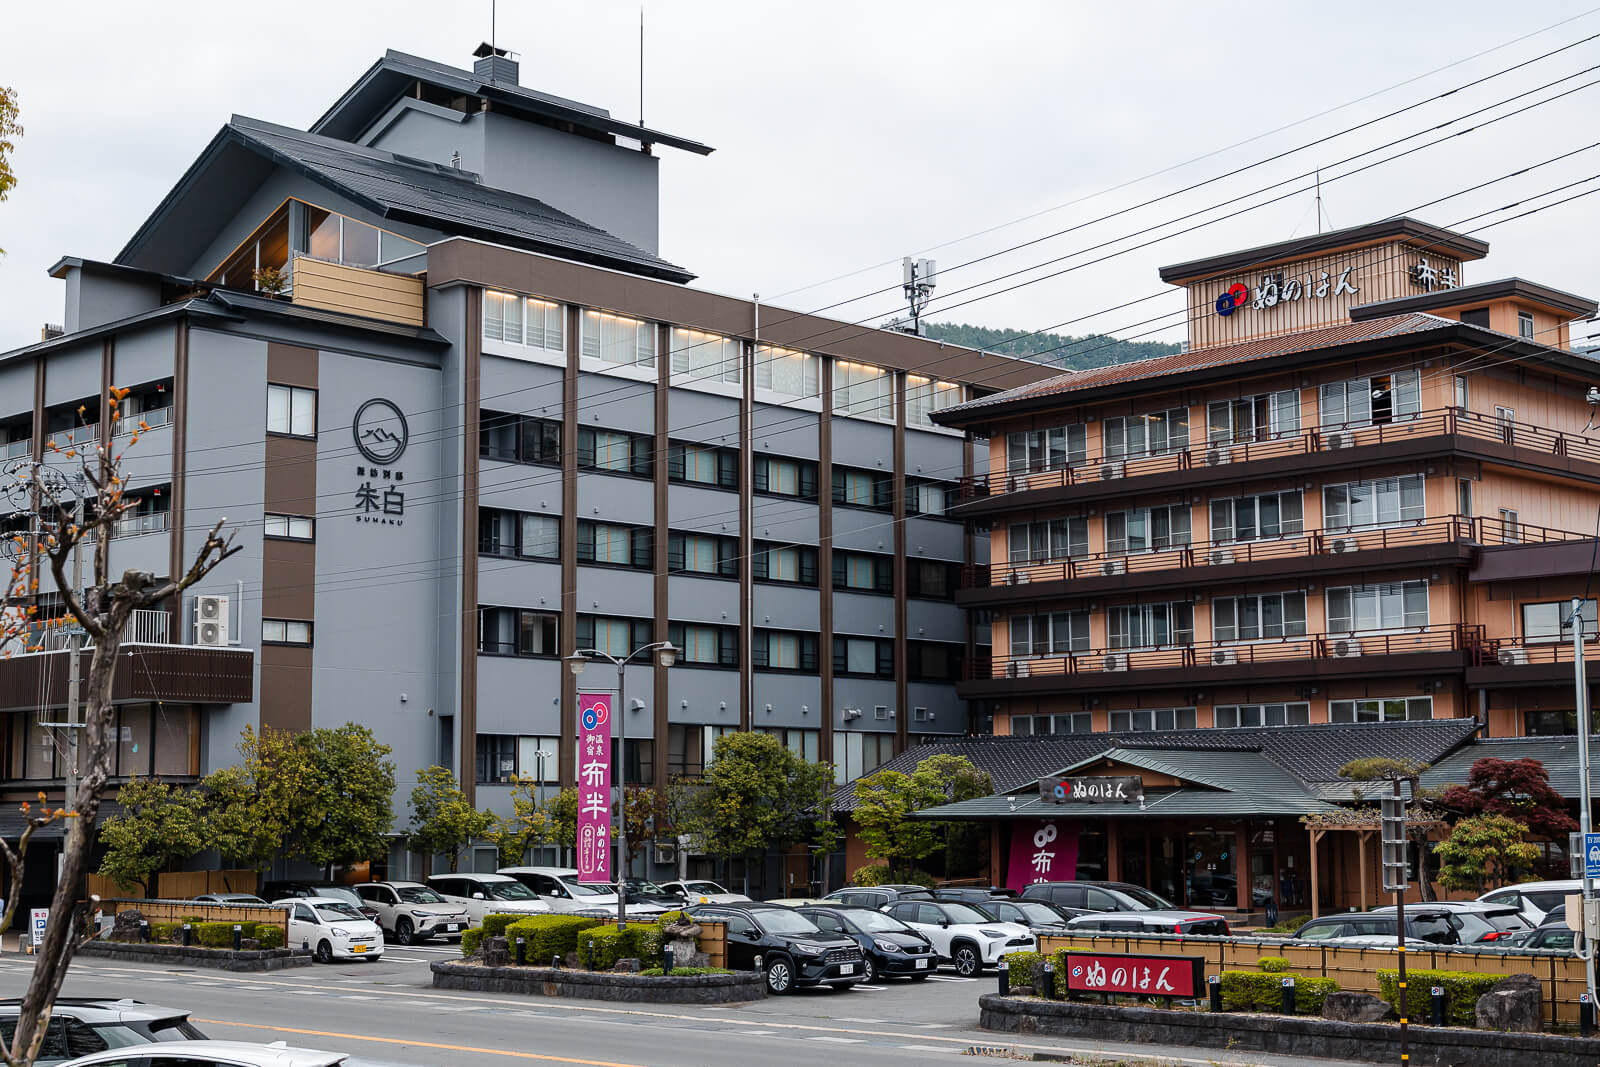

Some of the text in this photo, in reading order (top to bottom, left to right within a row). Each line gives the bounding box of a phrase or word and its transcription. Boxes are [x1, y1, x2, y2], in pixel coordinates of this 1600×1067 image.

[1252, 265, 1360, 311] ぬのはん
[1416, 258, 1459, 291] 布半
[355, 481, 405, 516] 朱白
[581, 758, 608, 820] 布半
[1073, 781, 1128, 800] ぬのはん
[596, 823, 606, 873] ぬのはん
[1031, 849, 1056, 883] 布
[1085, 959, 1175, 992] ぬのはん
